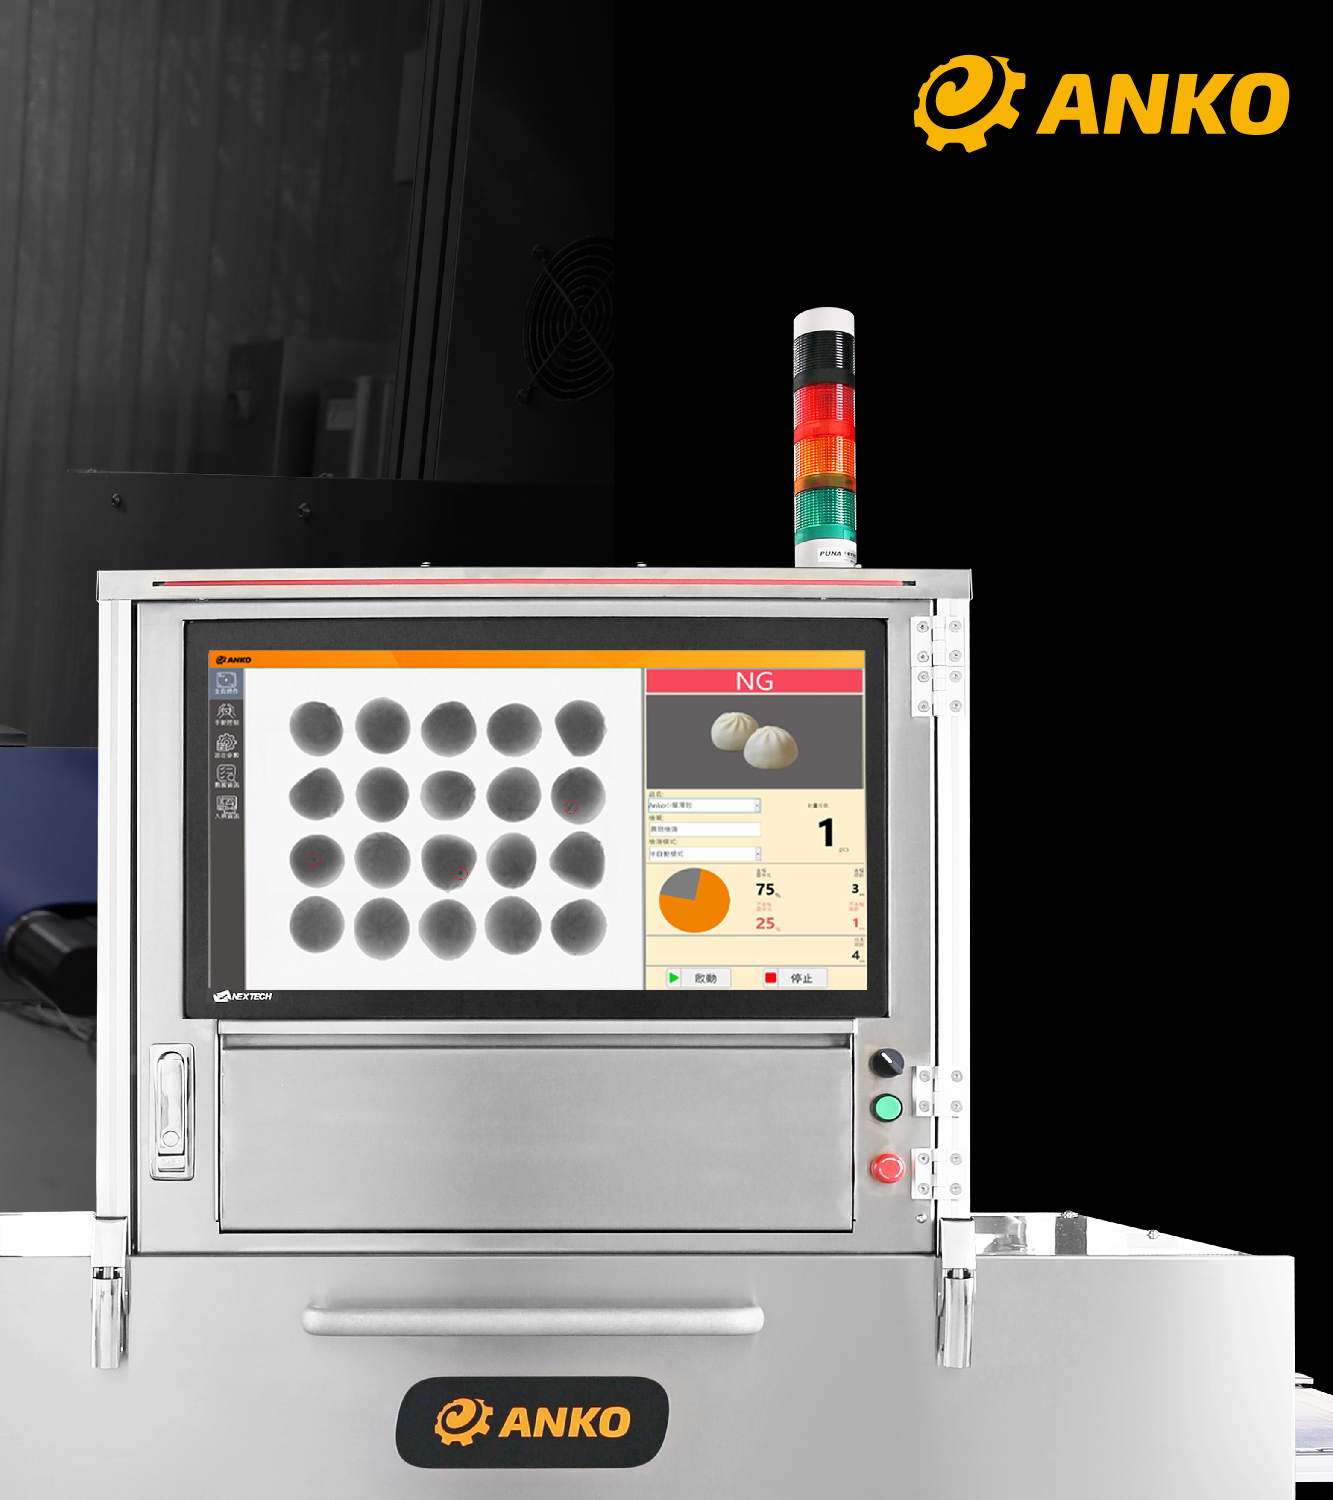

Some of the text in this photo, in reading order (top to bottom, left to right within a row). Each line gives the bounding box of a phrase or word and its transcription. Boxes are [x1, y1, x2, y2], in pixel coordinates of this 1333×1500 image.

[227, 656, 252, 664] ANKO
[736, 671, 773, 691] NG
[818, 817, 833, 847] 1
[851, 883, 859, 894] 3
[790, 972, 814, 984] 停止
[232, 992, 273, 1001] NEXTECH
[498, 1406, 631, 1438] ANKO
